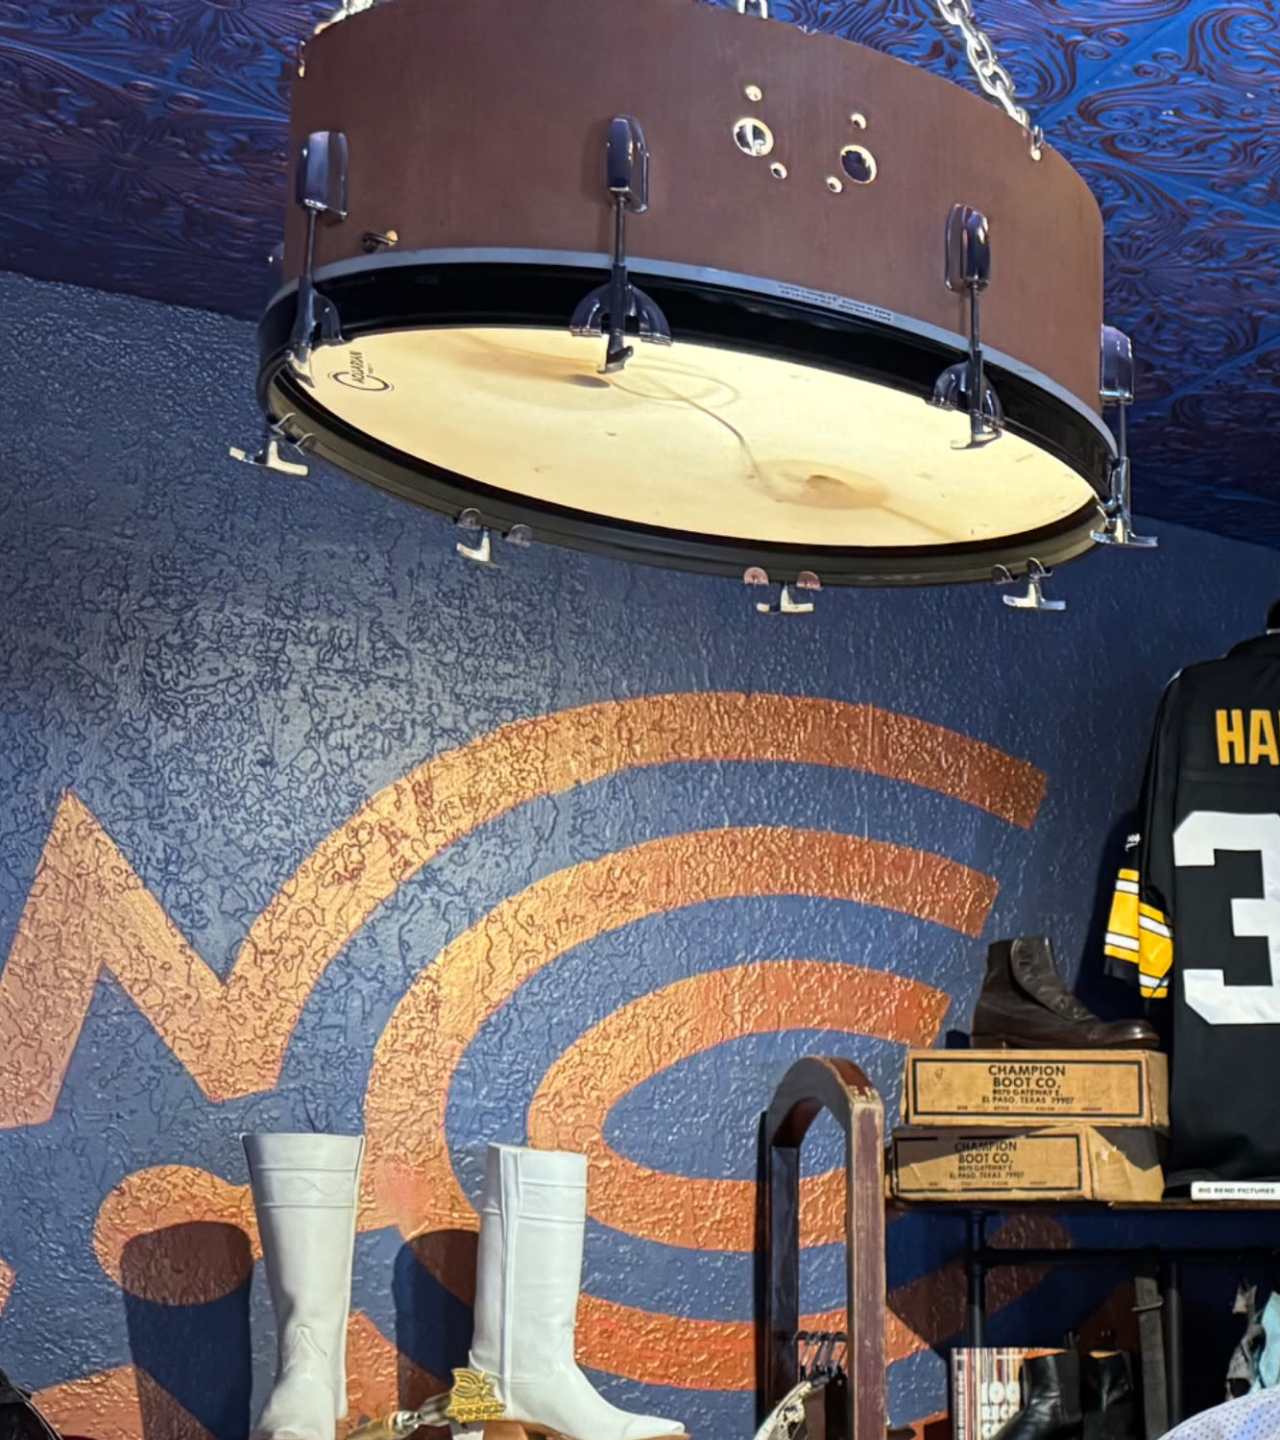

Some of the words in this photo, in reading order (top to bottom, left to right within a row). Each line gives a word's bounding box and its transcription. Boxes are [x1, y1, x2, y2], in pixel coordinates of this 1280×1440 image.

[988, 1064, 1066, 1077] CHAMPION
[993, 1077, 1031, 1089] BOOT
[1020, 1096, 1046, 1104] TEXAS
[954, 1141, 1017, 1152] CHAMPION
[958, 1153, 989, 1164] BOOT
